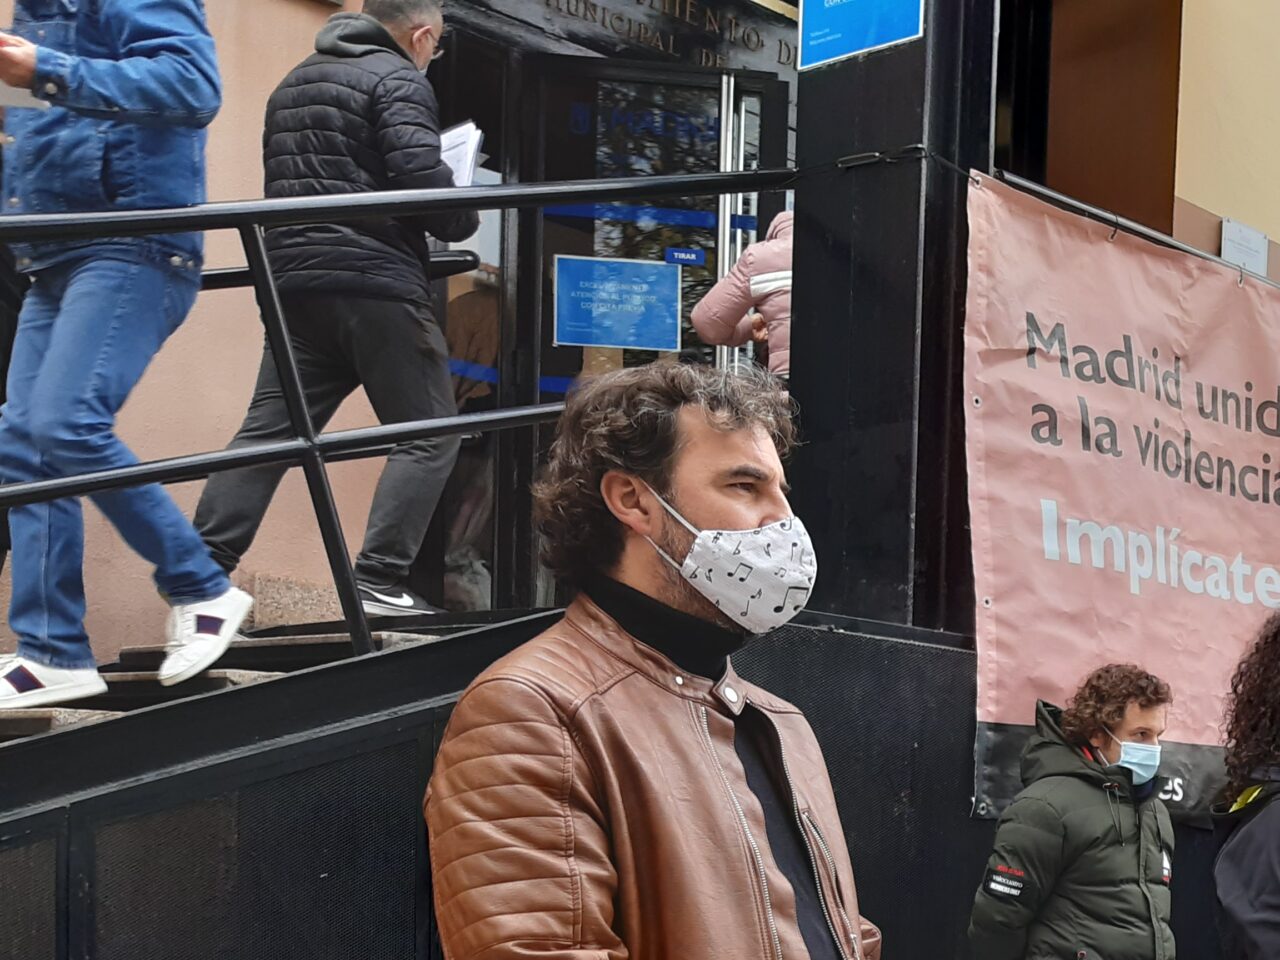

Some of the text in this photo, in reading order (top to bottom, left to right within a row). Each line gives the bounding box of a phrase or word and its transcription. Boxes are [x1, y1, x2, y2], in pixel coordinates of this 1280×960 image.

[672, 252, 697, 260] TIRAR
[1025, 311, 1183, 410] Madrid
[1030, 403, 1063, 447] a
[1077, 395, 1123, 458] la
